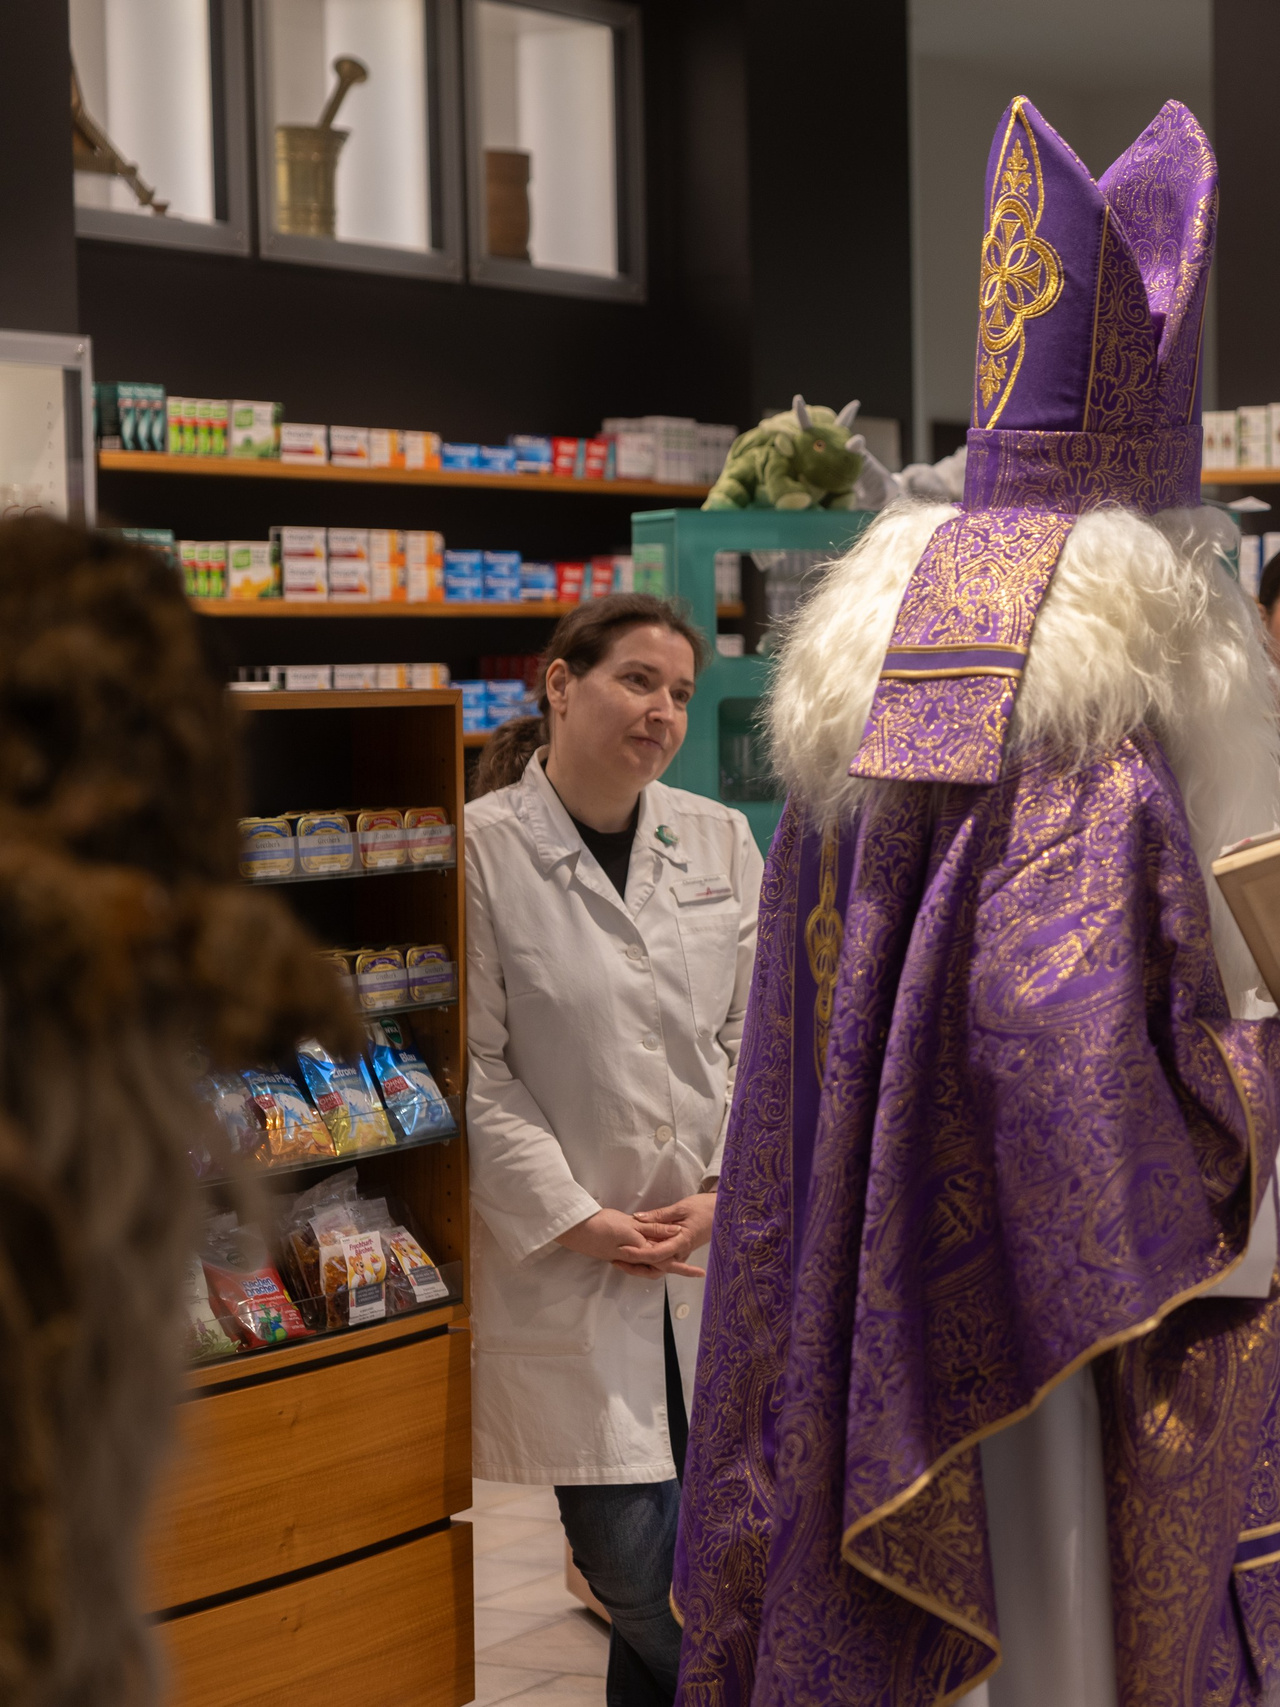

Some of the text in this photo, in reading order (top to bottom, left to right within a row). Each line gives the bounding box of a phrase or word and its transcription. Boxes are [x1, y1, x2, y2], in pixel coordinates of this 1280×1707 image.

[399, 1052, 417, 1063] Blau
[332, 1068, 357, 1079] Zitrone
[242, 1277, 273, 1288] Rachen
[245, 1284, 279, 1297] Drachen
